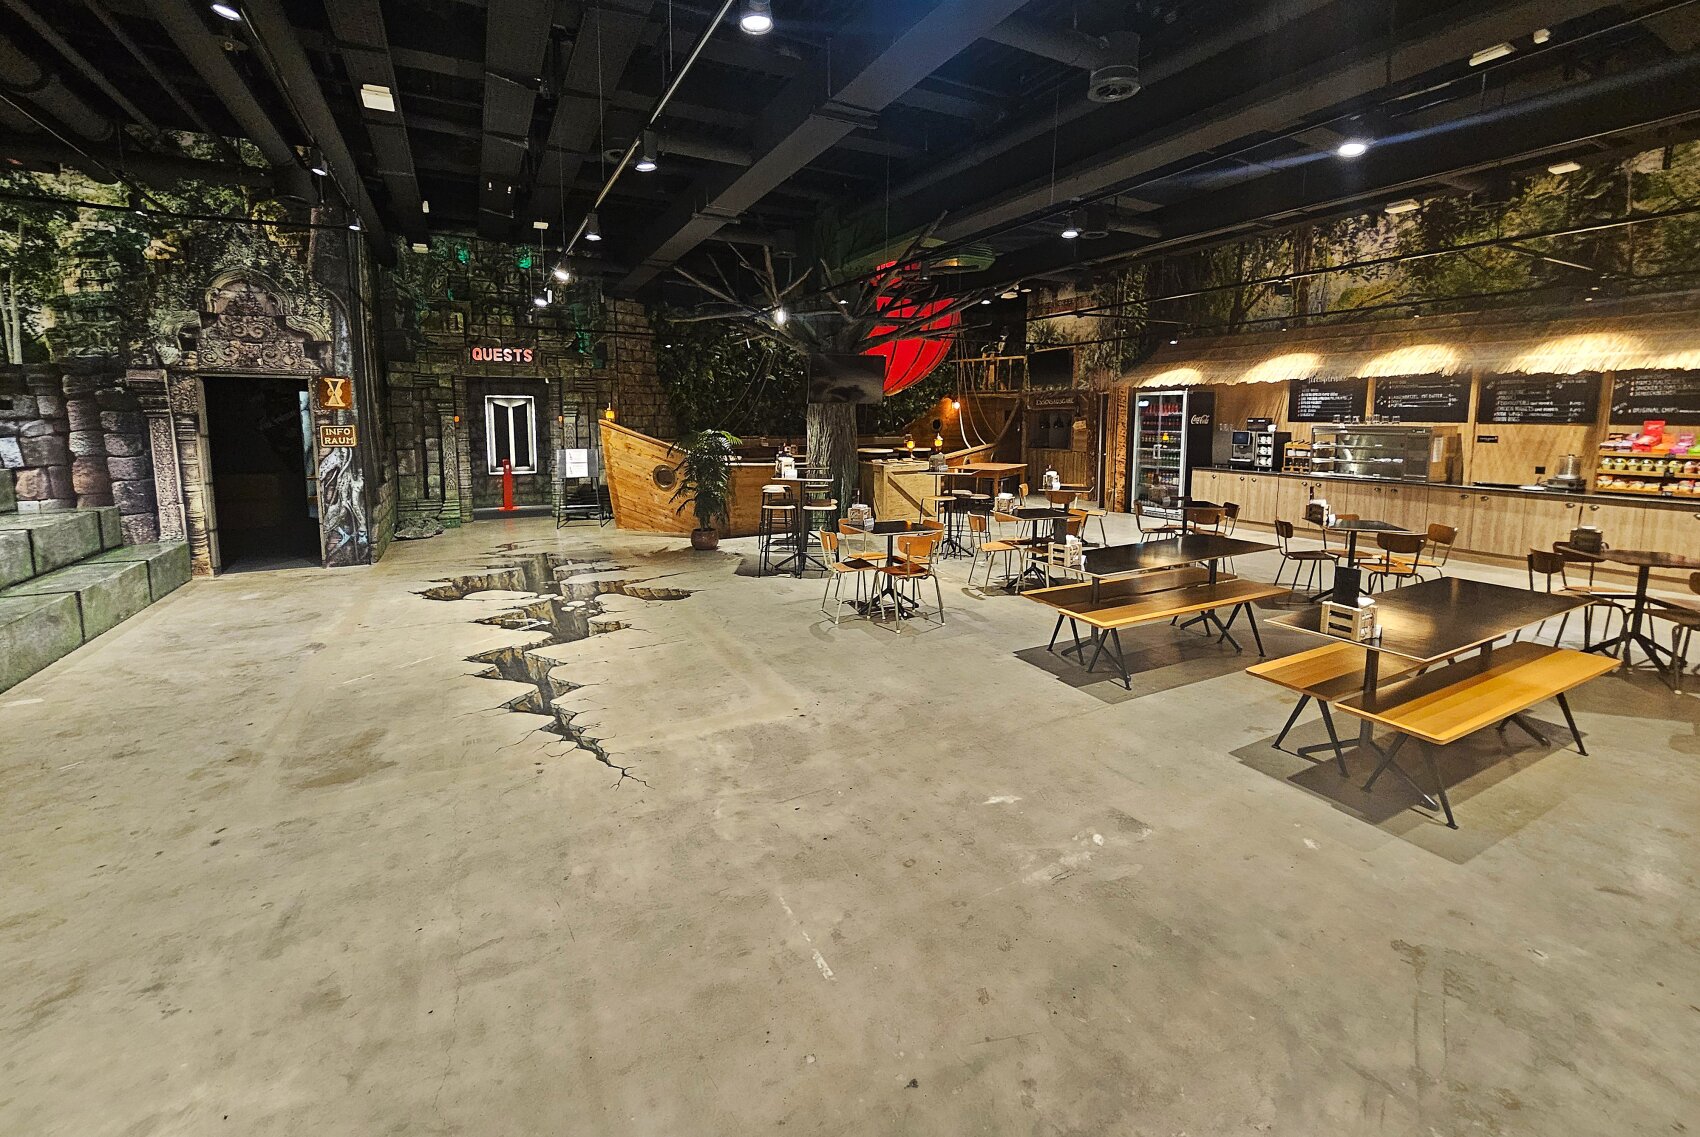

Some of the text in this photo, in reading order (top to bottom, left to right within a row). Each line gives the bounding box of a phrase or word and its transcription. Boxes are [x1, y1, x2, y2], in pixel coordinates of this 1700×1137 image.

[472, 347, 533, 363] QUESTS
[325, 428, 351, 436] INFO
[324, 437, 354, 445] RAUM
